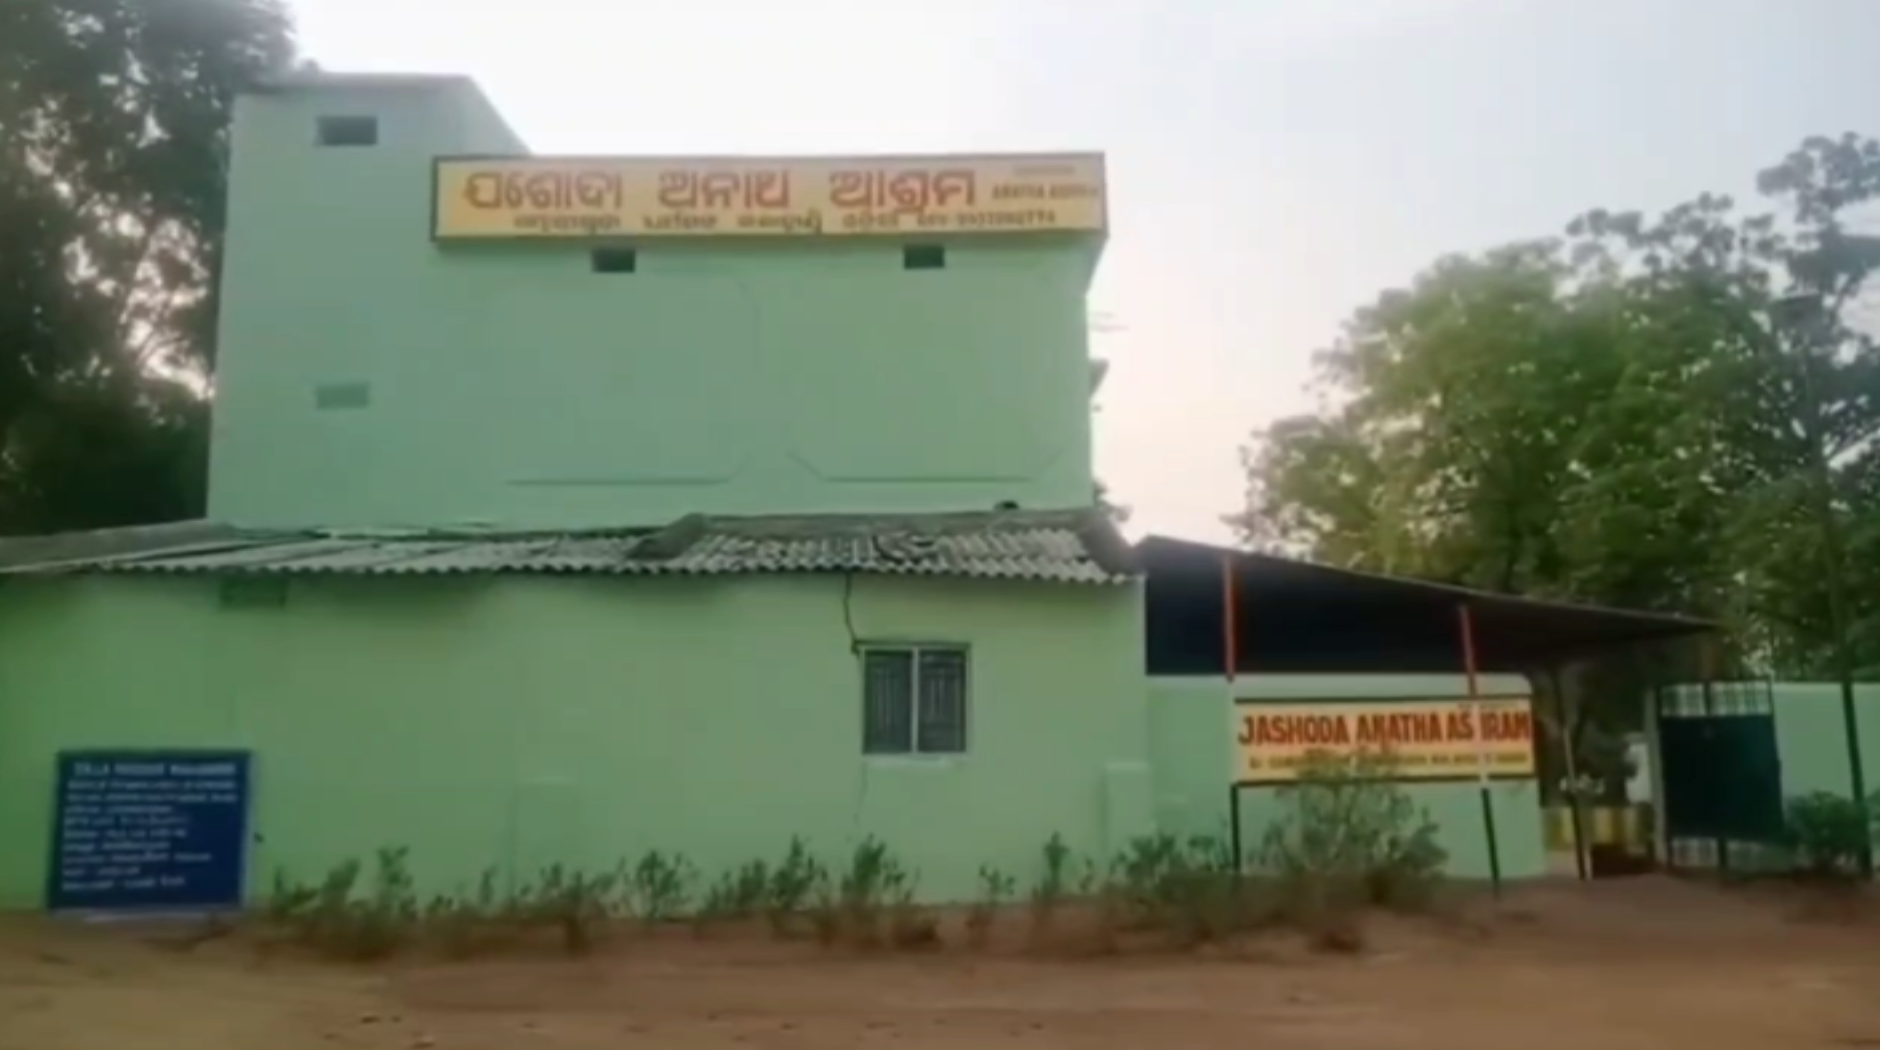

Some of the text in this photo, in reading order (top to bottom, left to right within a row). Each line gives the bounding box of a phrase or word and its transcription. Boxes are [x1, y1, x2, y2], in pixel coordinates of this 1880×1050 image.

[658, 169, 790, 208] ଅନାଥ
[828, 168, 976, 213] ଆଶ୍ରମ
[1237, 714, 1350, 746] JASHODA
[1357, 712, 1442, 743] ANATHA
